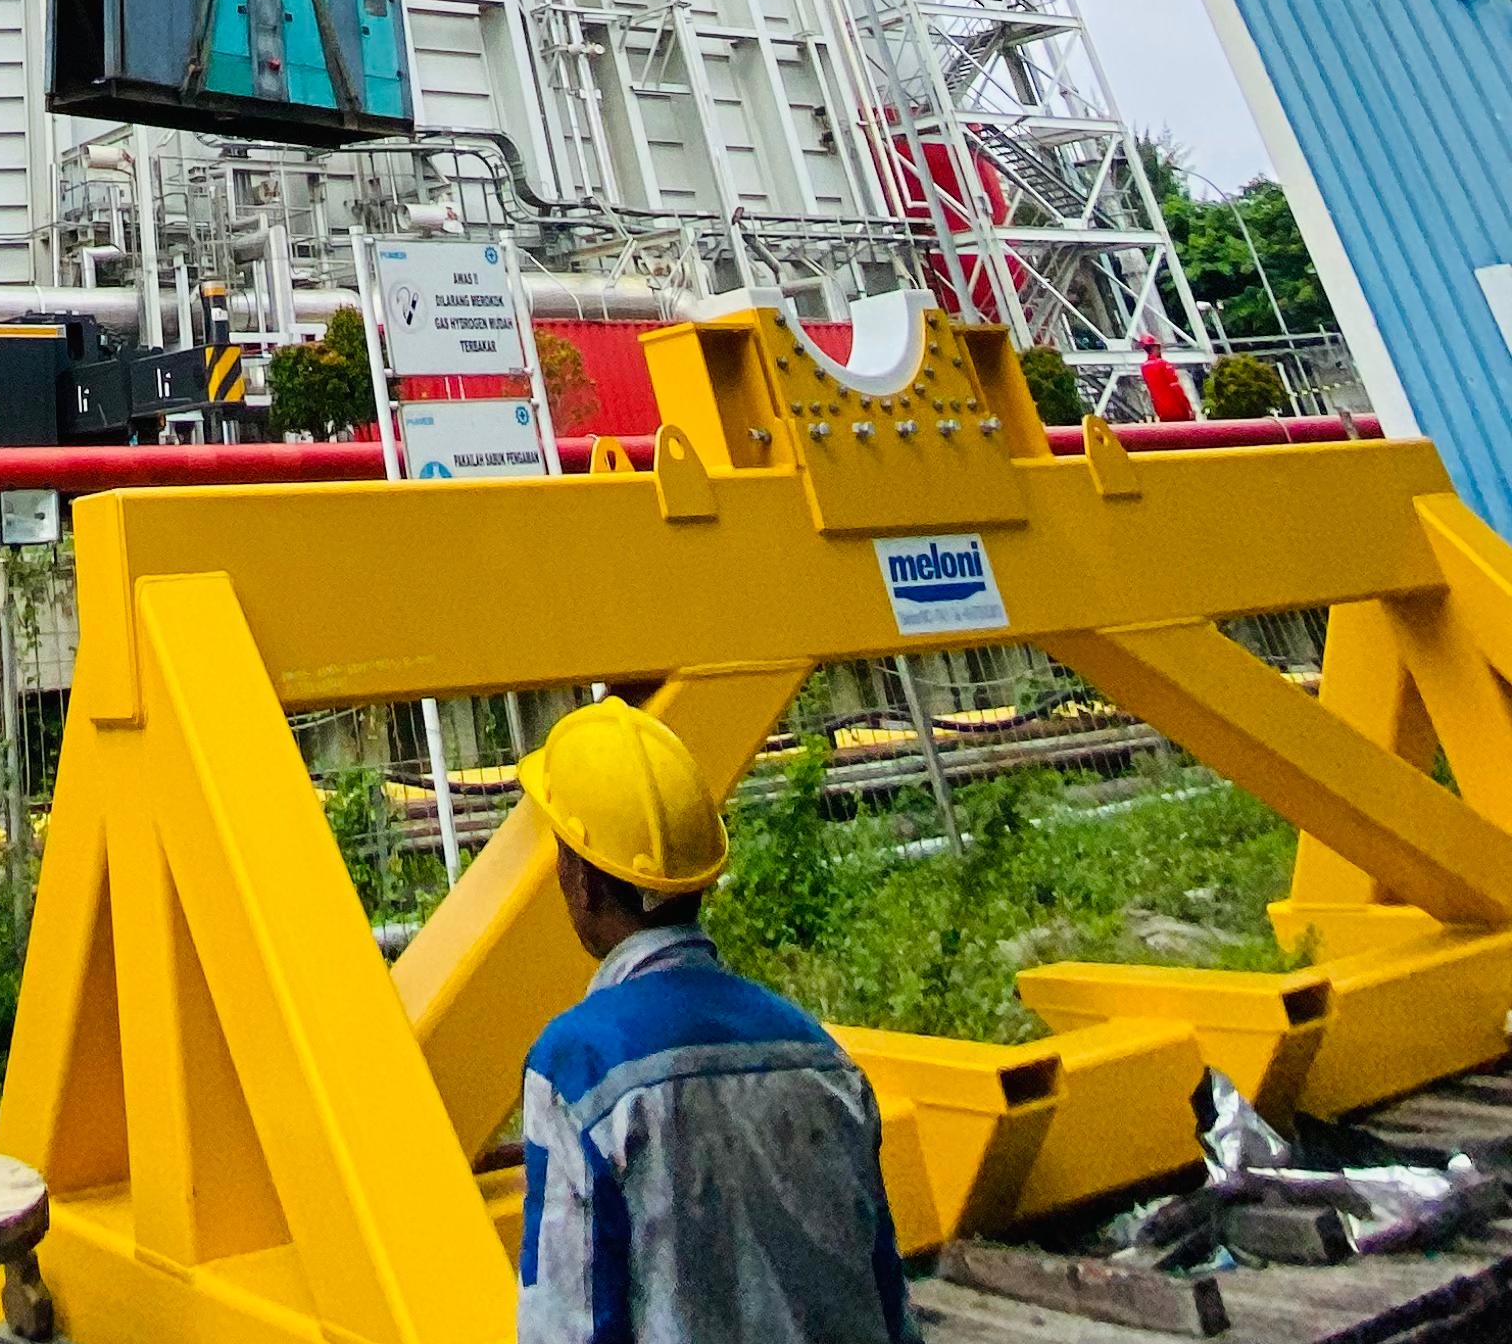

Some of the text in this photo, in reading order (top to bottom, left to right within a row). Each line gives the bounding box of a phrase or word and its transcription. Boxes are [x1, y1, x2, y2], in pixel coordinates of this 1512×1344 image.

[435, 294, 505, 307] DILARANG MEROKOK
[434, 317, 449, 330] GAS
[888, 540, 983, 583] meloni
